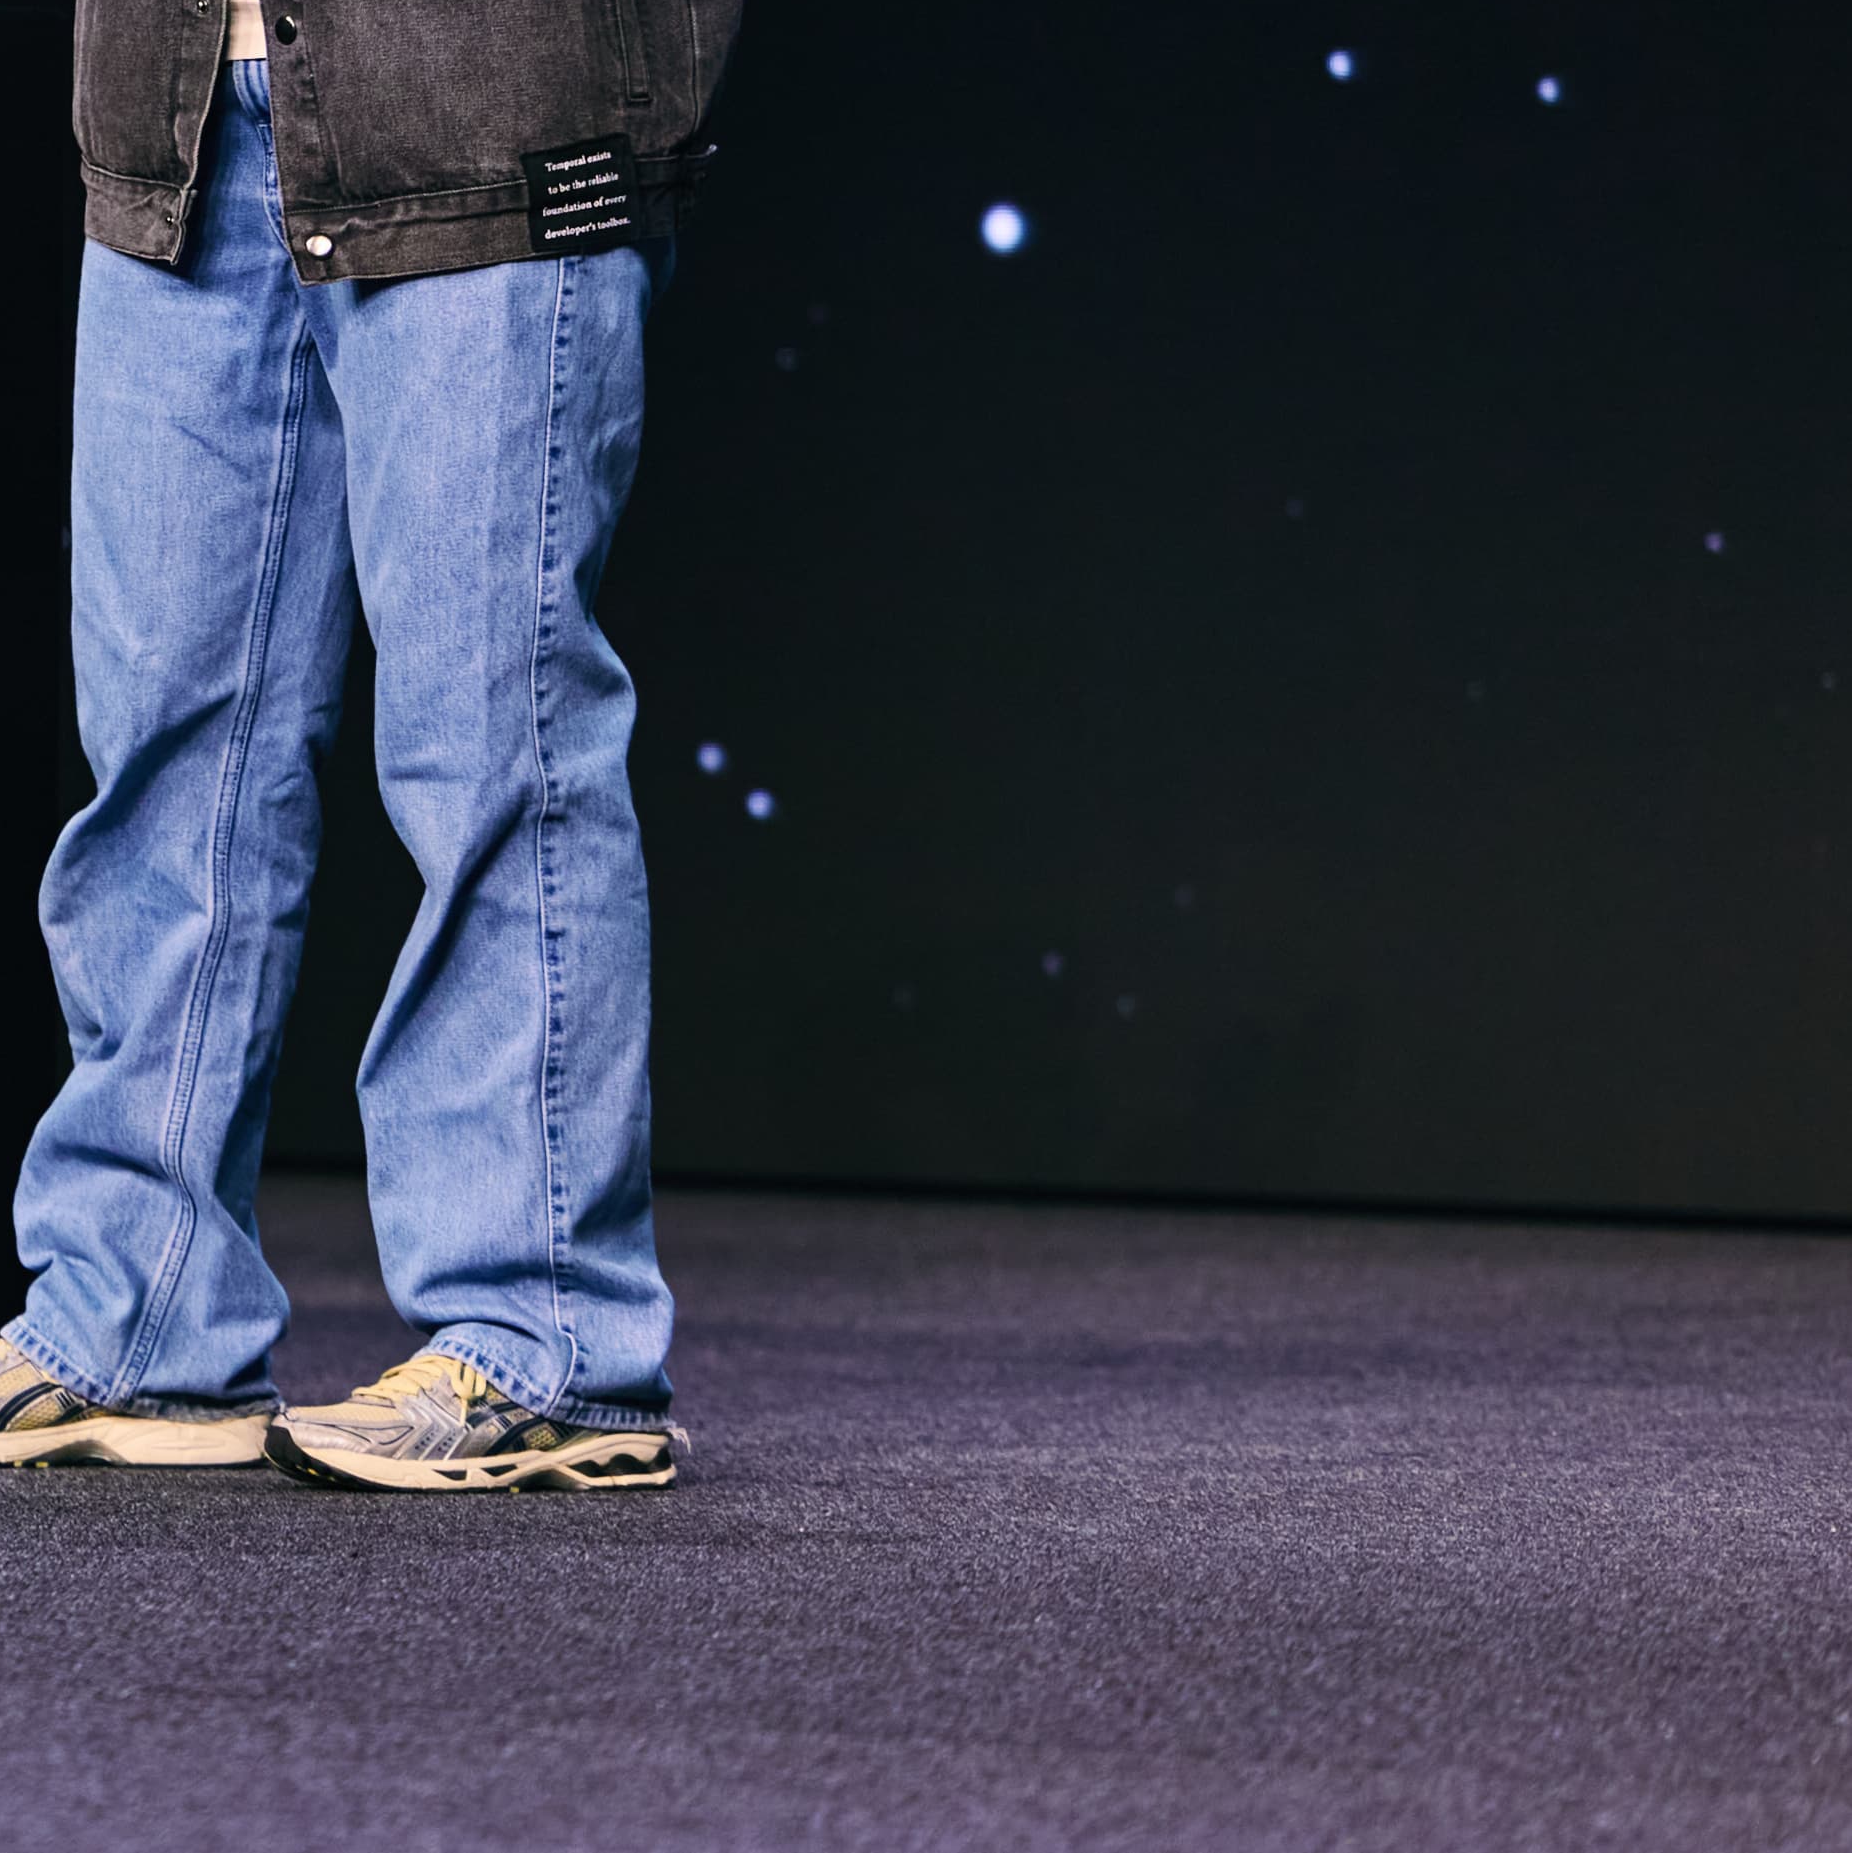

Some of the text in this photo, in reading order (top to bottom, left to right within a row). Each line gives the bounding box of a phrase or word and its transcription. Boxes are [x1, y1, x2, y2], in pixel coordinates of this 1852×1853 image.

[545, 151, 612, 172] Temporal exists
[548, 172, 619, 195] to be the reliable
[542, 195, 627, 217] foundation of every
[544, 222, 597, 240] developer's
